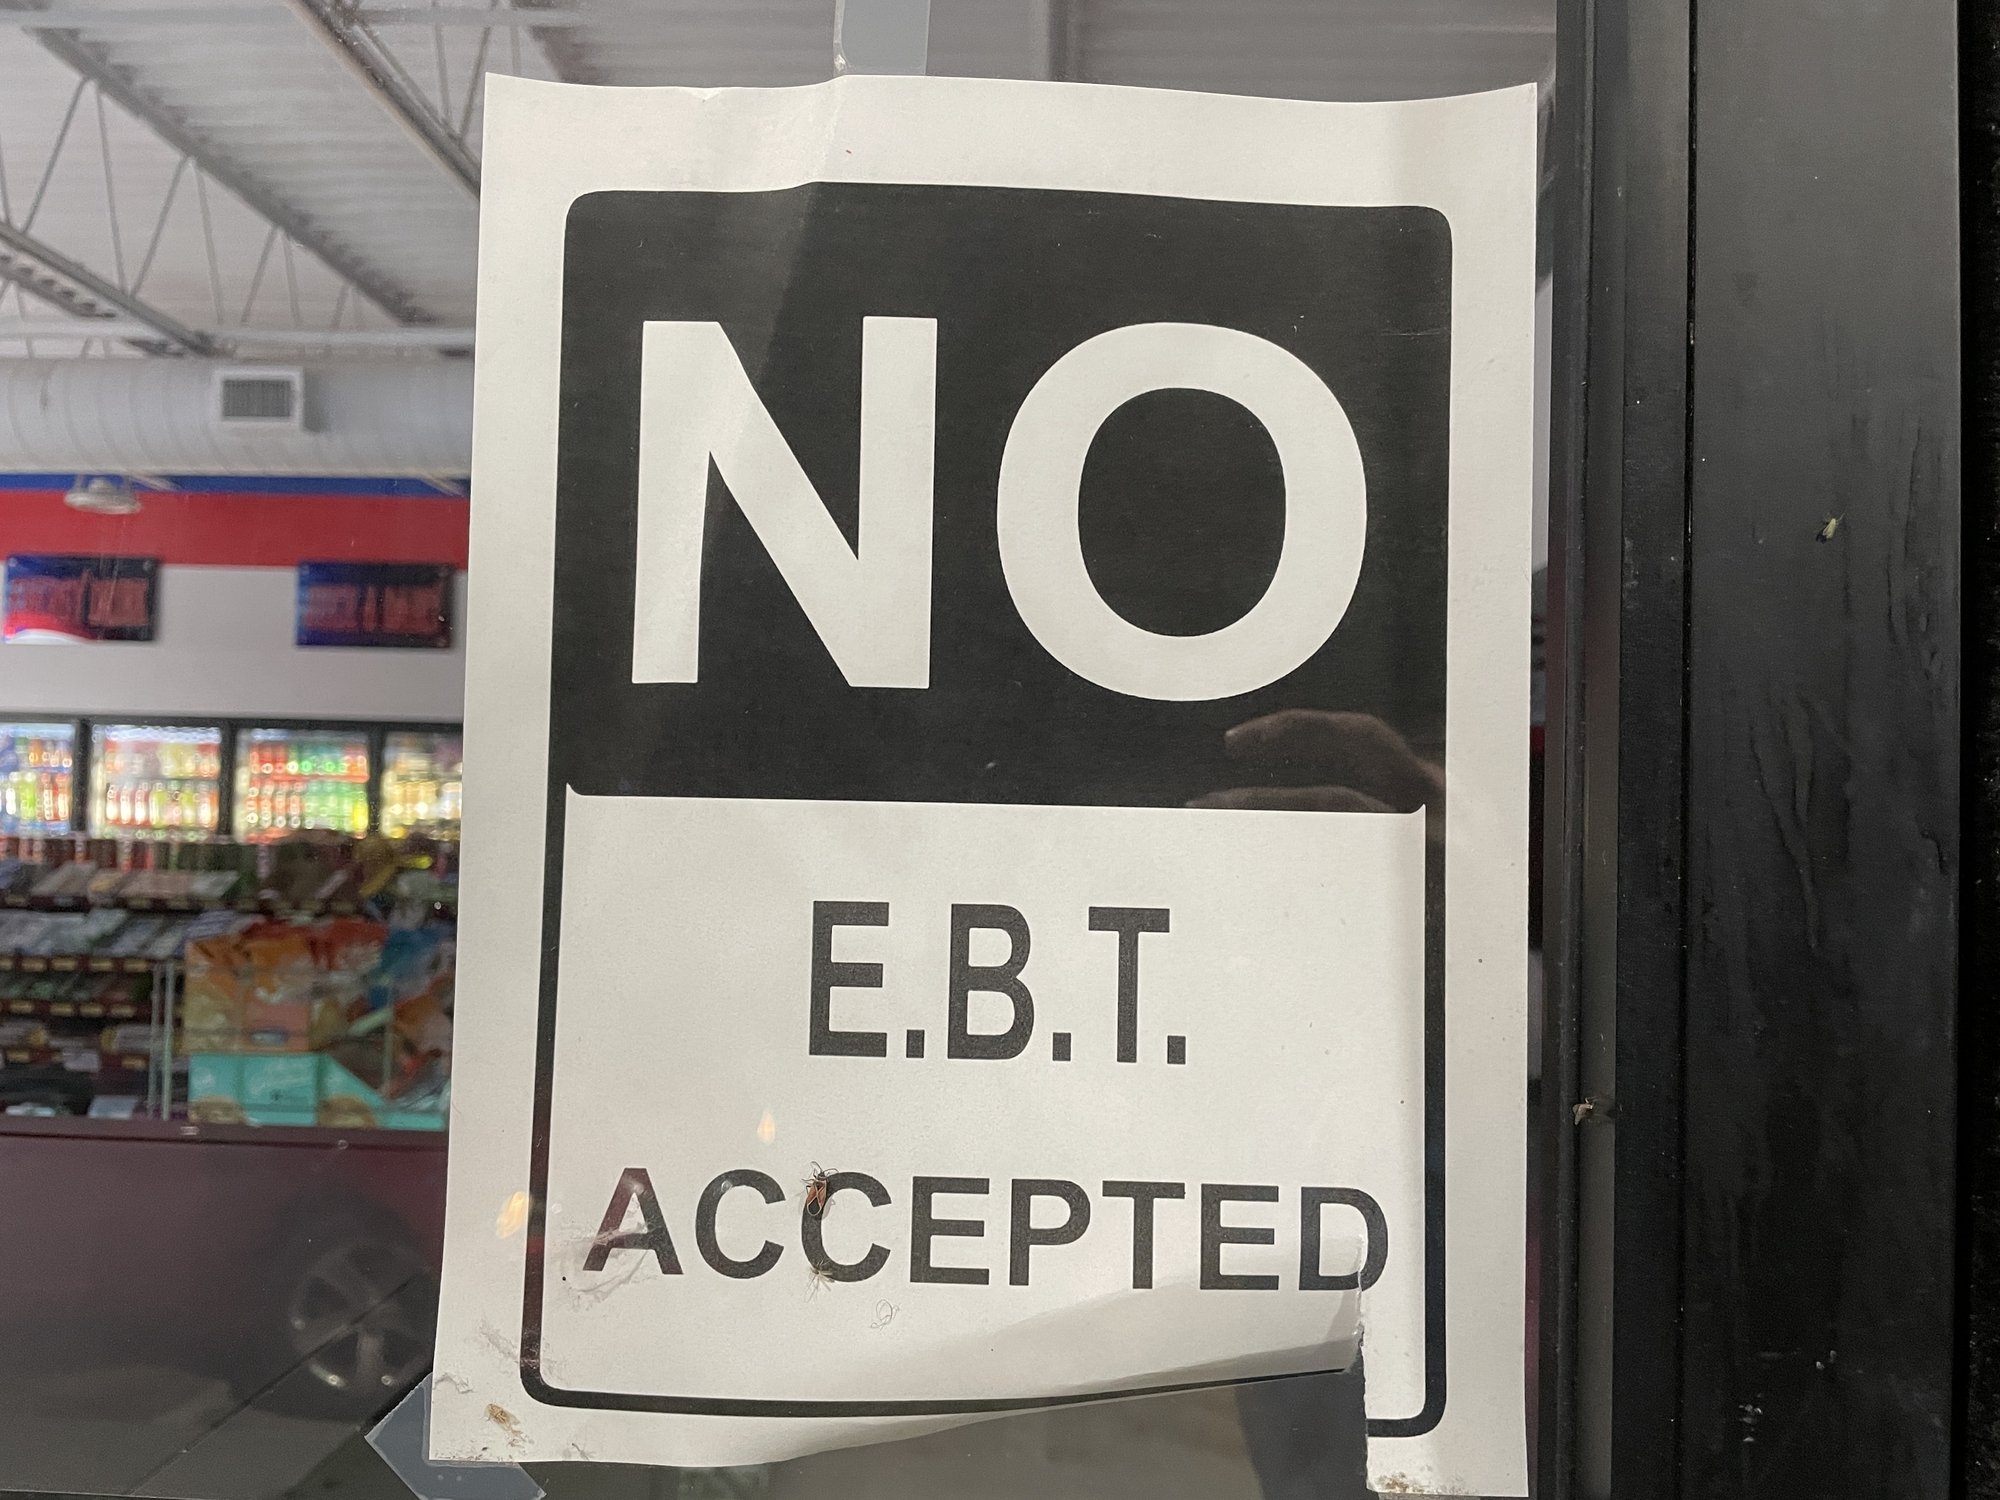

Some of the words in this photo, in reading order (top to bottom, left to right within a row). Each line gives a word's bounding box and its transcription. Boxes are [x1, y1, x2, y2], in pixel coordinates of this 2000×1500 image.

[632, 316, 1367, 701] NO
[808, 900, 1187, 1065] E.B.T.
[582, 1166, 1389, 1292] ACCEPTED
